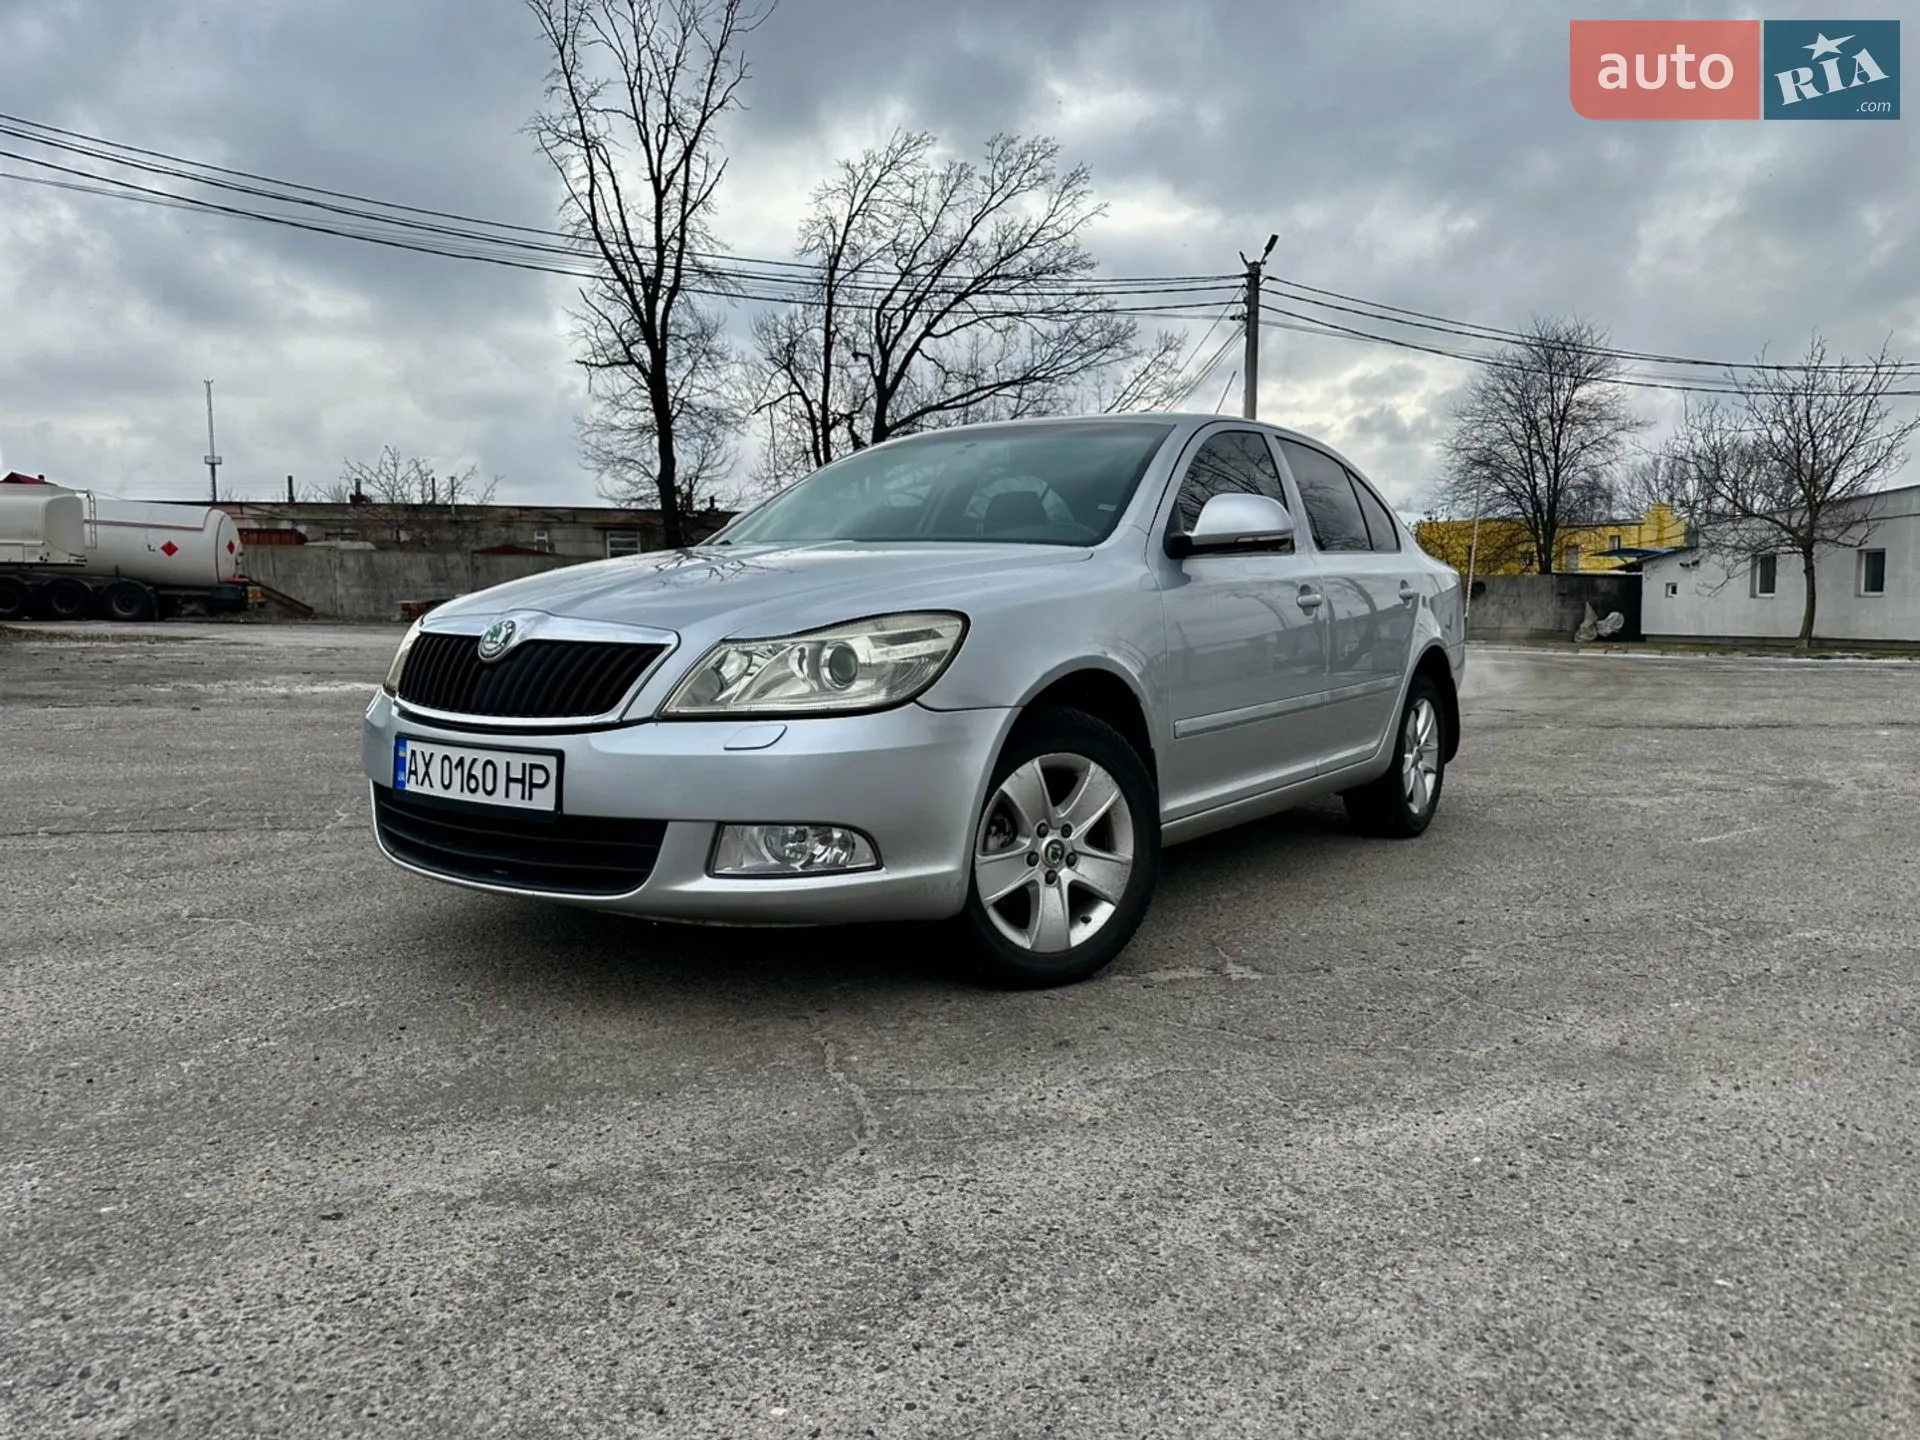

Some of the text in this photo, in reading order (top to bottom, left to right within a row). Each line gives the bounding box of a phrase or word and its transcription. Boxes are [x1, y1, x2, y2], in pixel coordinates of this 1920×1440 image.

[407, 749, 551, 801] AX 0160 HP
